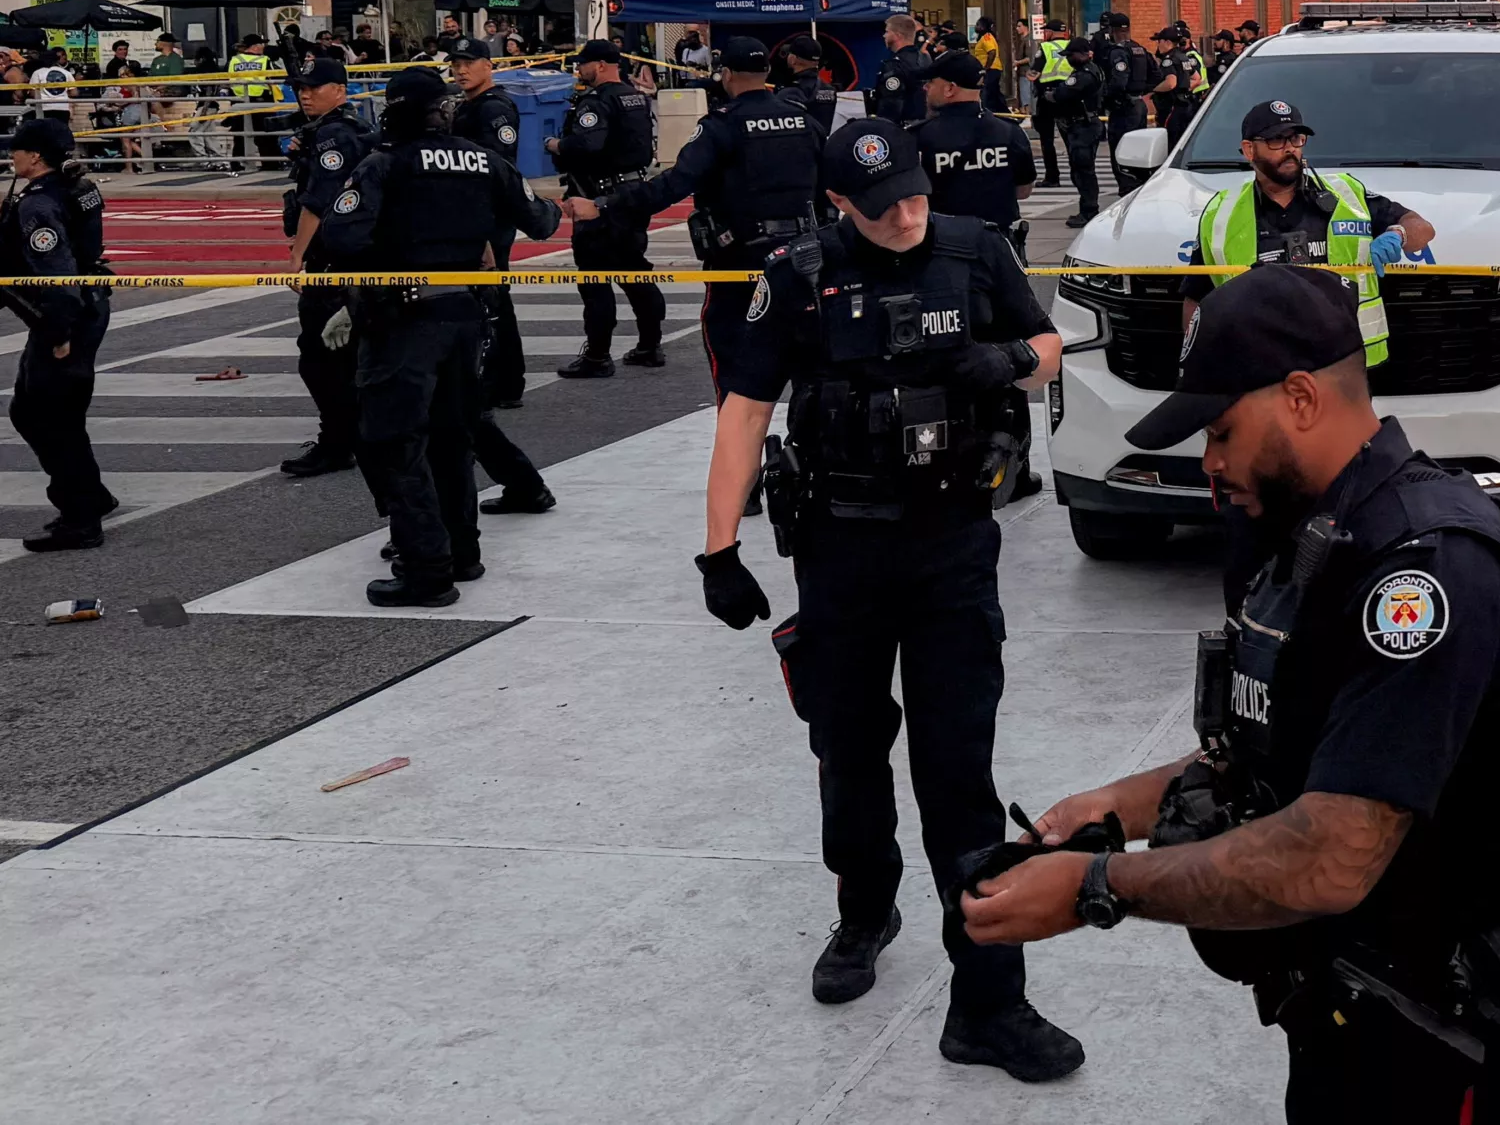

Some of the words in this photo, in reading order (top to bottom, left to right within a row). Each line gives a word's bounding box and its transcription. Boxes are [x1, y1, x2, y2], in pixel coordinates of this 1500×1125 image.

[737, 0, 754, 8] MEDIC
[234, 62, 262, 71] POLICE
[745, 116, 805, 132] POLICE
[420, 149, 490, 173] POLICE
[1338, 222, 1371, 234] POLIC
[256, 277, 300, 286] POLICE
[306, 277, 332, 286] LINE
[339, 277, 354, 286] DO
[360, 277, 383, 286] NOT
[389, 277, 429, 286] CROSS
[501, 275, 545, 284] POLICE
[551, 275, 577, 284] LINE
[584, 275, 600, 283] DO
[605, 275, 628, 283] NOT
[634, 275, 675, 283] CROSS
[922, 310, 961, 336] POLICE
[1376, 576, 1434, 596] TORONTO
[1383, 631, 1427, 650] POLICE
[1231, 670, 1271, 724] POLICE
